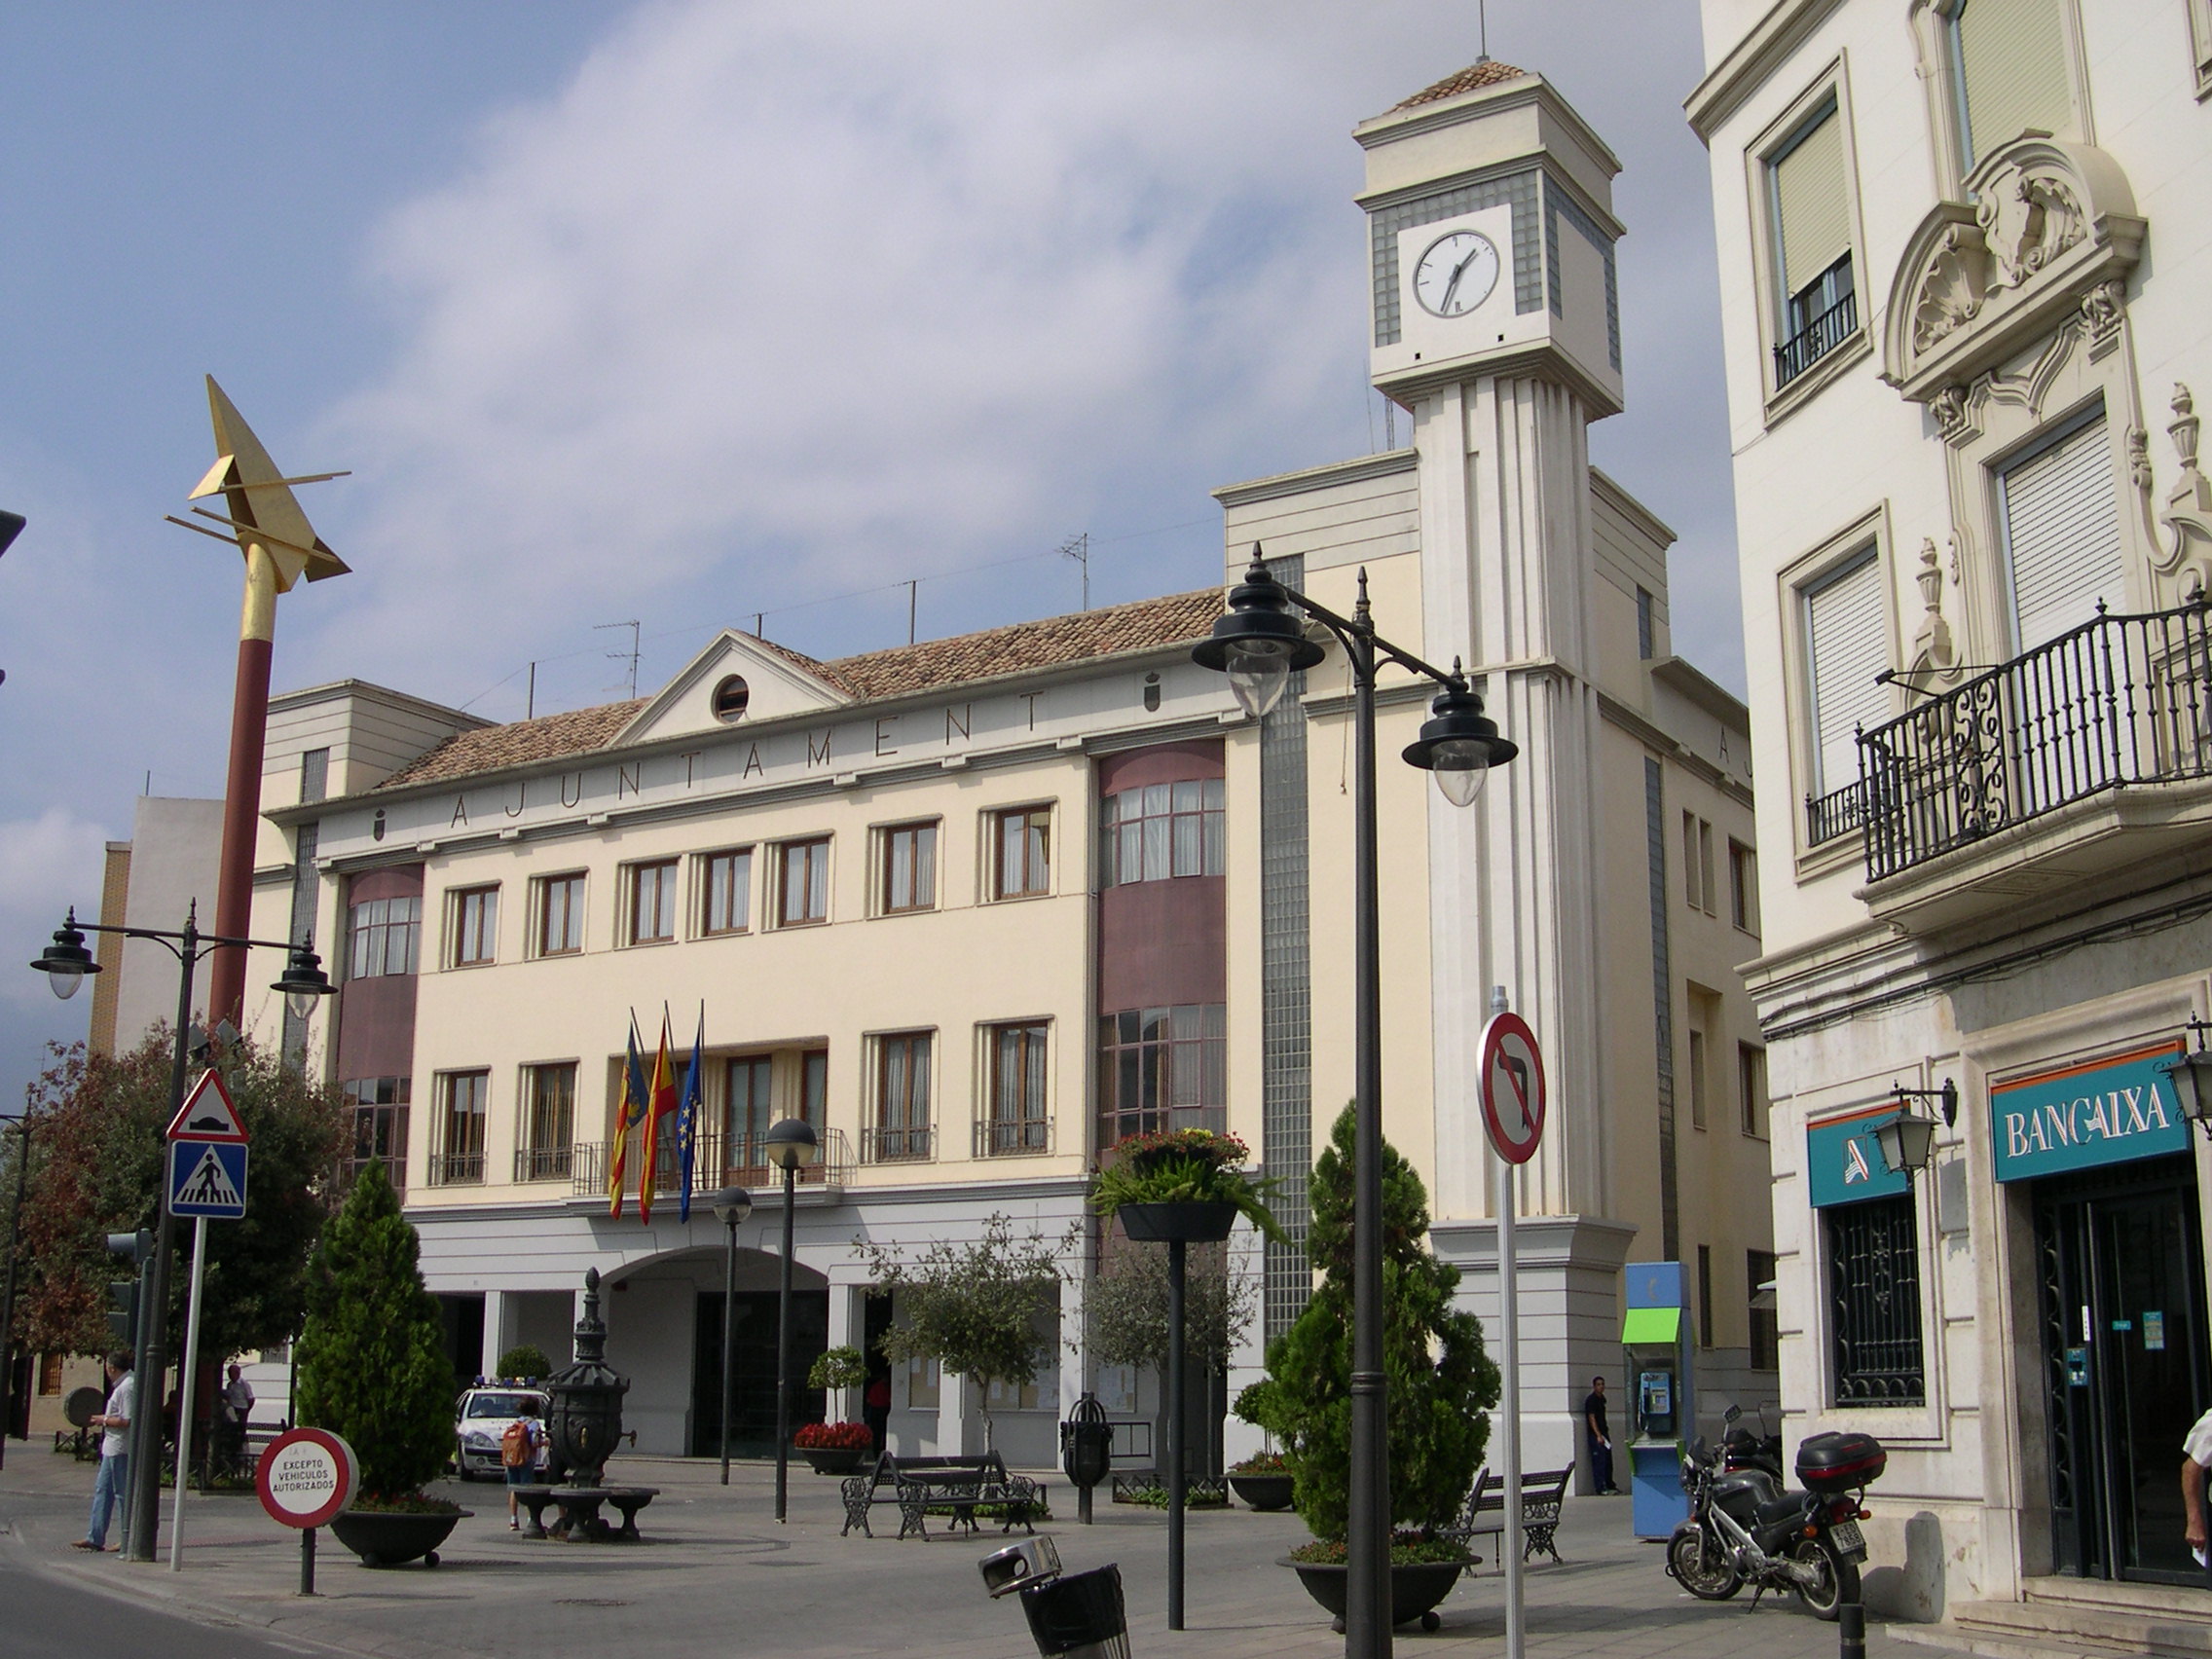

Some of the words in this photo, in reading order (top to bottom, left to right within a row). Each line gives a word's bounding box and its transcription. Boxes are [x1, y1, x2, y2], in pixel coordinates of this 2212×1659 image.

[451, 689, 1045, 829] AJUNTAMENT
[2006, 1082, 2171, 1159] BANCAIXA
[282, 1458, 323, 1469] EXCEPTO
[278, 1470, 328, 1481] VEHICULOS
[273, 1481, 334, 1492] AUTORIZADOS
